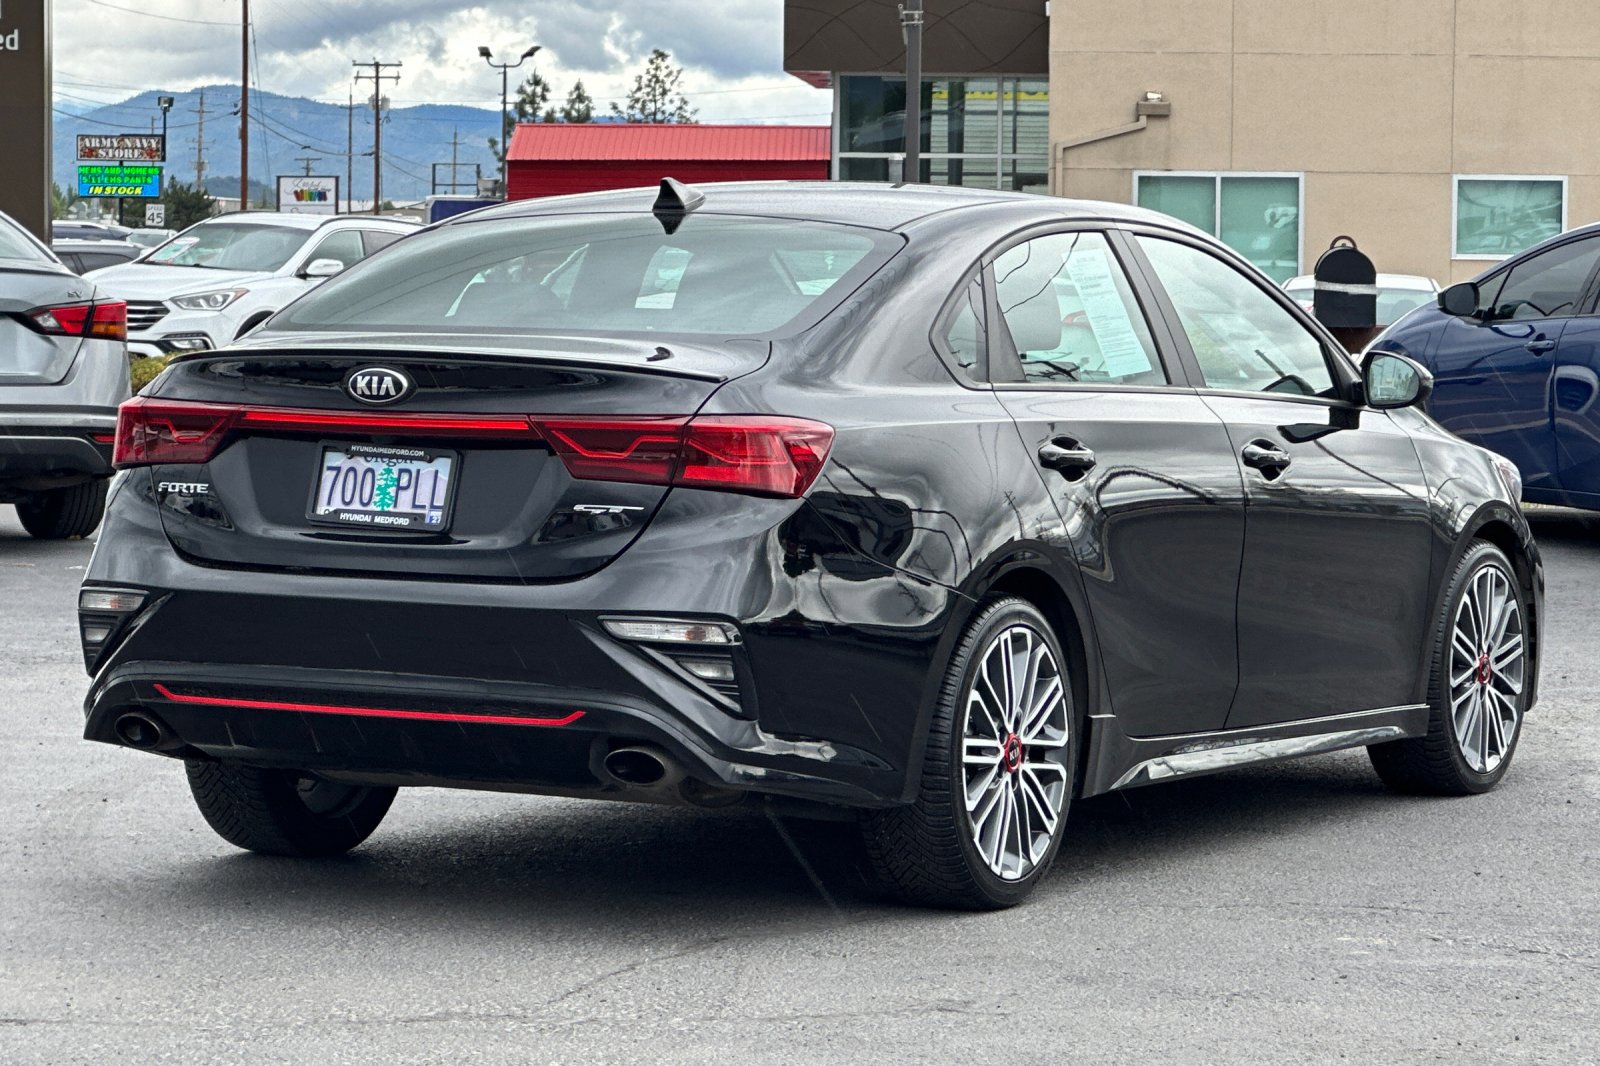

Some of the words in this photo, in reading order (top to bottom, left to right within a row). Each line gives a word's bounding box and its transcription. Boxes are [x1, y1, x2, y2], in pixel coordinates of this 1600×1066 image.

[83, 137, 119, 148] ARMY
[124, 138, 158, 149] NAVY
[98, 148, 142, 158] STORE
[104, 166, 121, 174] AND
[89, 186, 103, 195] IN
[104, 186, 143, 195] STOCK
[147, 212, 163, 224] 45
[356, 375, 397, 396] KIA
[351, 444, 425, 457] HYUNDAIMEDFORD.COM
[158, 481, 209, 494] FORTE
[326, 465, 377, 507] 700
[393, 467, 444, 510] PLL
[340, 512, 372, 523] HYUNDAI
[374, 515, 410, 526] MEDFORD
